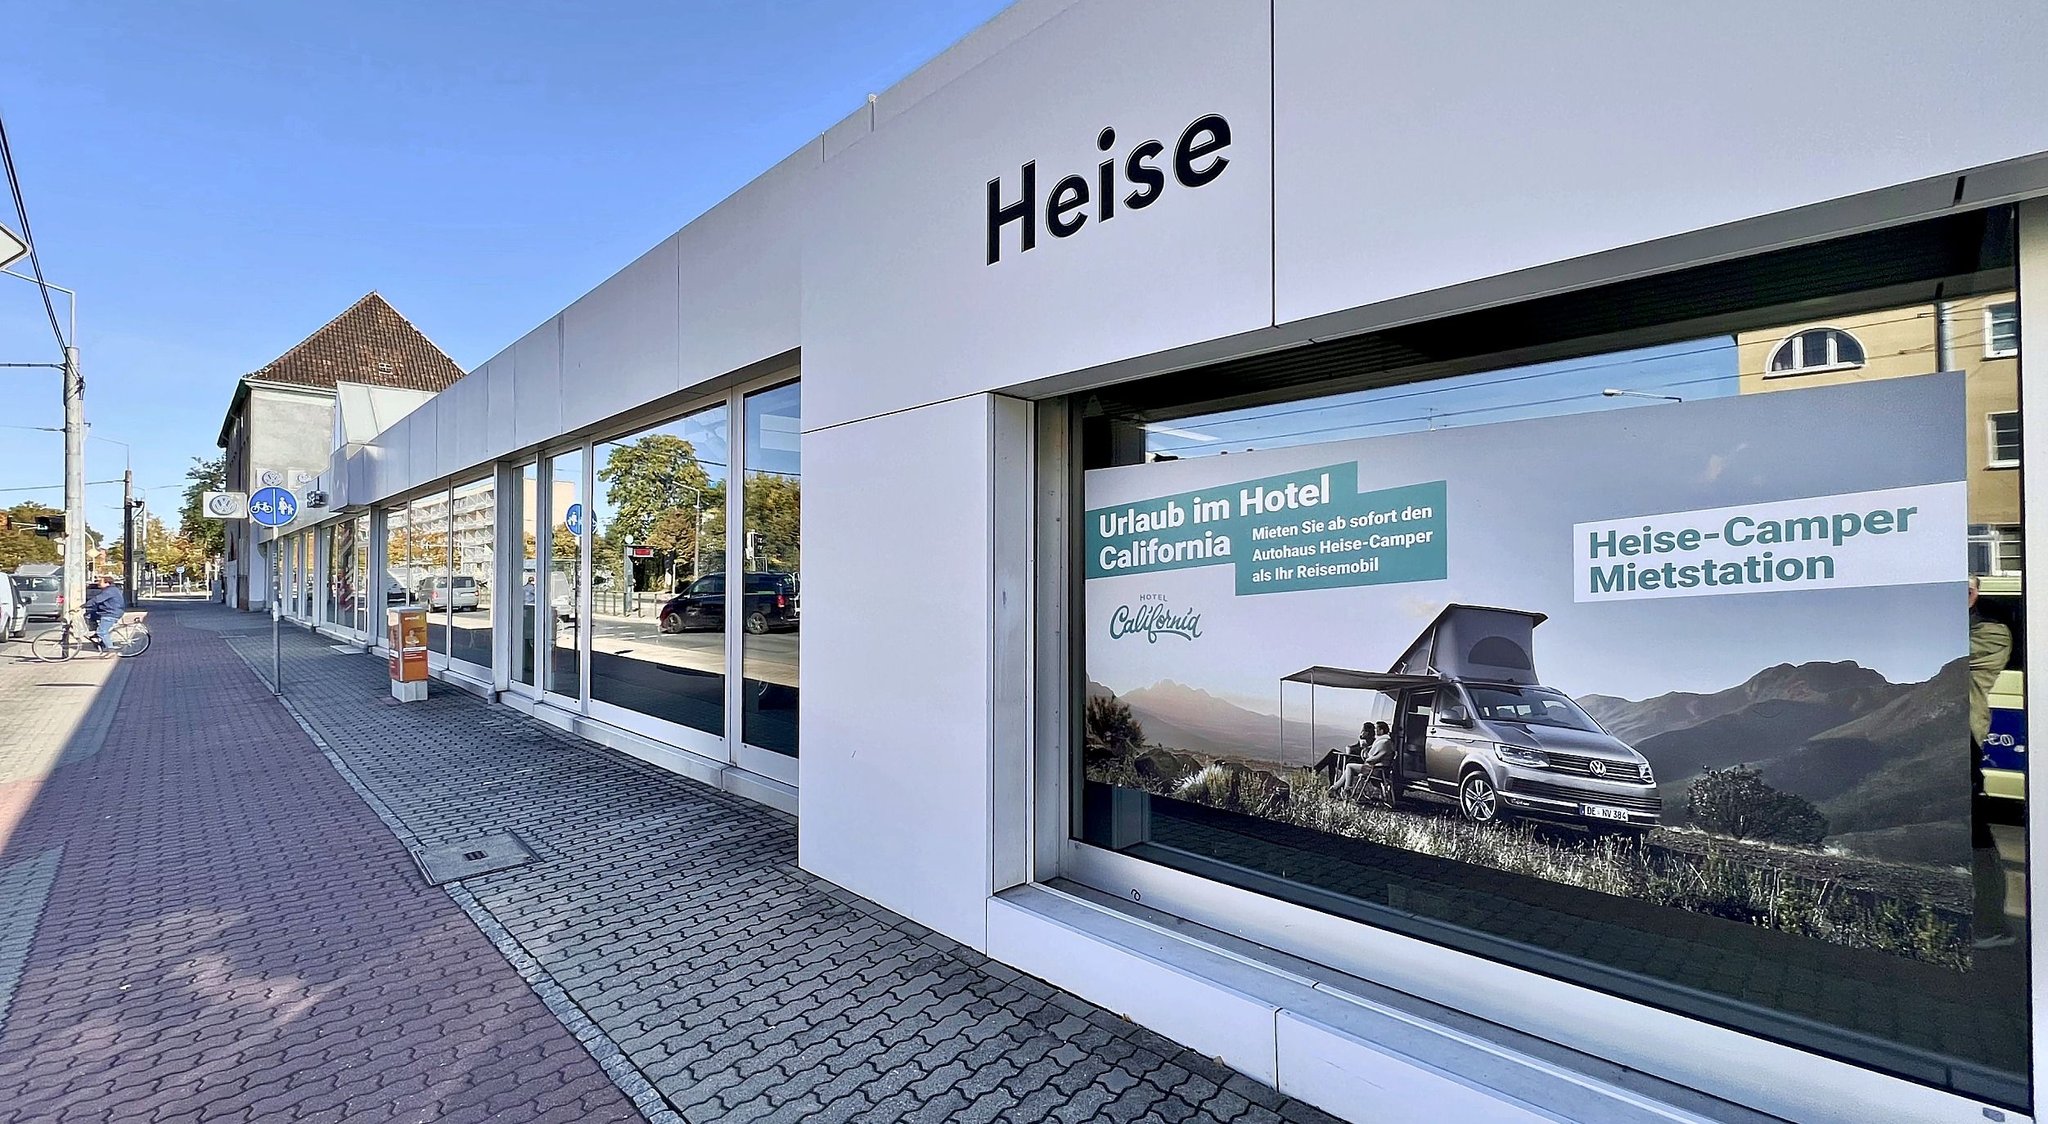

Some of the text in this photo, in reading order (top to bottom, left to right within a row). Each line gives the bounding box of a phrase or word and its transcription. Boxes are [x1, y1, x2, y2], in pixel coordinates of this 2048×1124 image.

[986, 113, 1232, 266] Heise
[1099, 473, 1331, 539] Urlaub im Hotel
[1252, 504, 1433, 542] Mieten Sie ab sofort den
[1099, 530, 1231, 571] California
[1252, 529, 1434, 562] Autohaus Heise-Camper
[1590, 505, 1918, 560] Heise-Camper
[1252, 558, 1379, 583] als Ihr Reisemobil
[1590, 550, 1835, 594] Mietstation
[1140, 594, 1168, 602] HOTEL
[1110, 603, 1203, 643] California
[1613, 810, 1626, 819] 384
